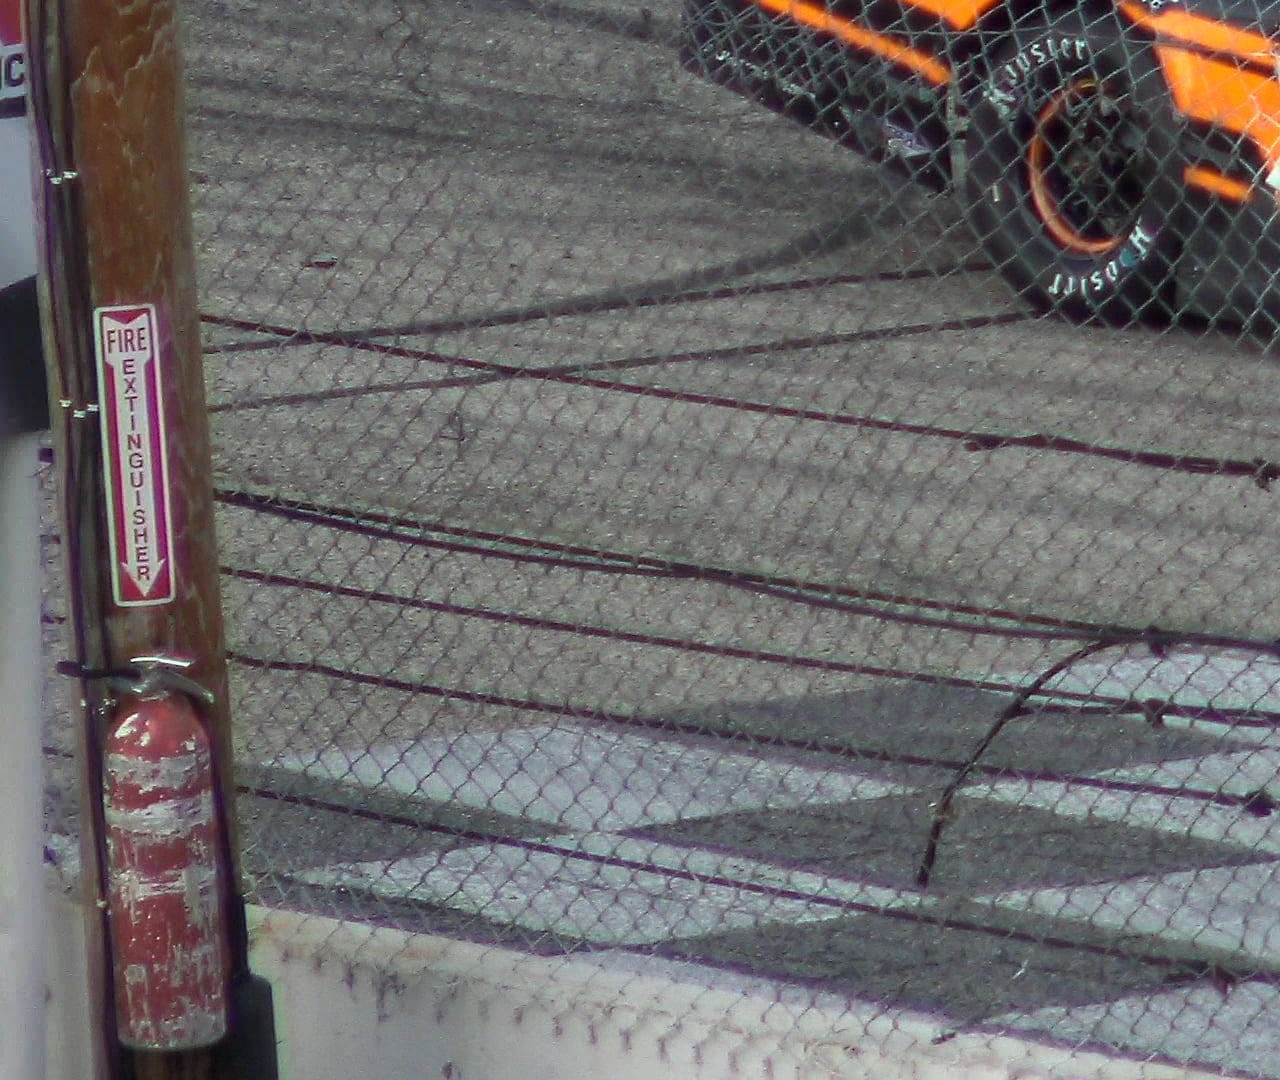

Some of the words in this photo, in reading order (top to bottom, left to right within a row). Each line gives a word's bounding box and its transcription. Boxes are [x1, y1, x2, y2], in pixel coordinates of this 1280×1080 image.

[1047, 218, 1151, 297] Hosier
[106, 327, 148, 354] FIRE
[121, 358, 151, 582] EXTINGUISHER
